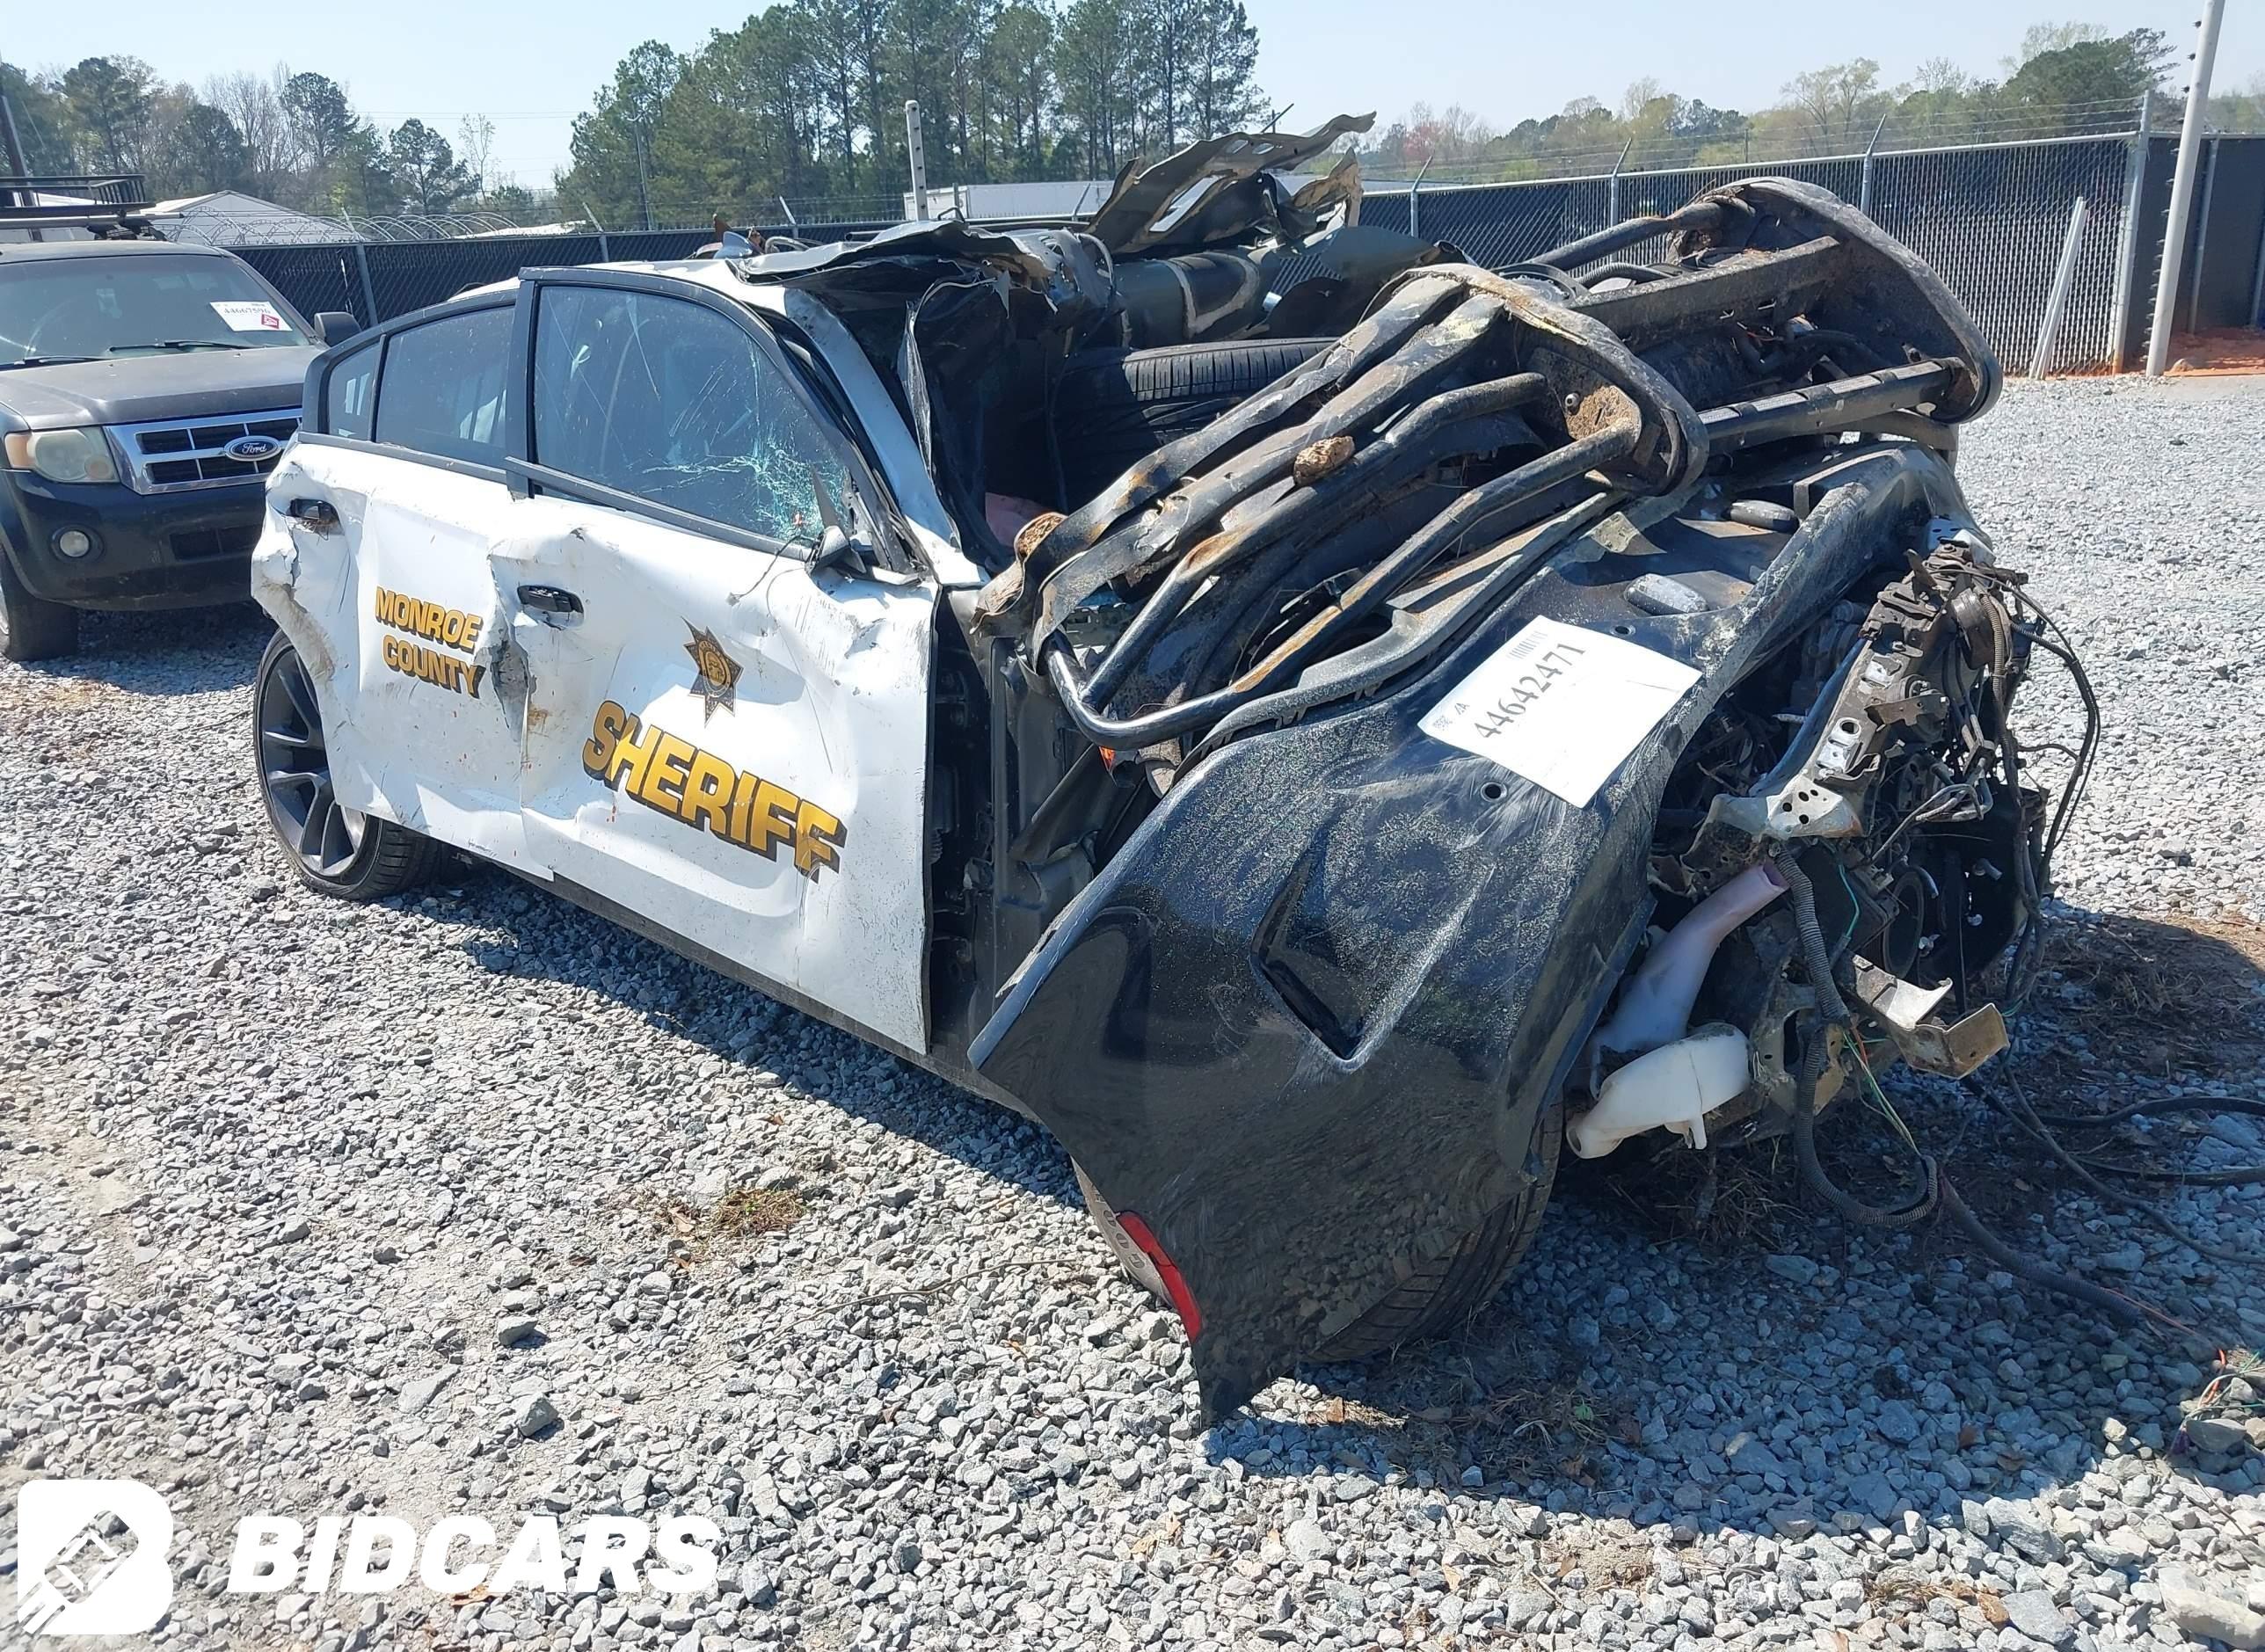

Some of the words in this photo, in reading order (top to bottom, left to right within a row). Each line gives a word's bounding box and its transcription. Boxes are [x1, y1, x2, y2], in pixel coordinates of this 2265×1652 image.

[242, 442, 267, 454] Ford
[376, 586, 483, 654] MONROE
[382, 635, 484, 698] COUNTY
[1475, 644, 1585, 738] 44642471
[582, 701, 848, 883] SHERIFF
